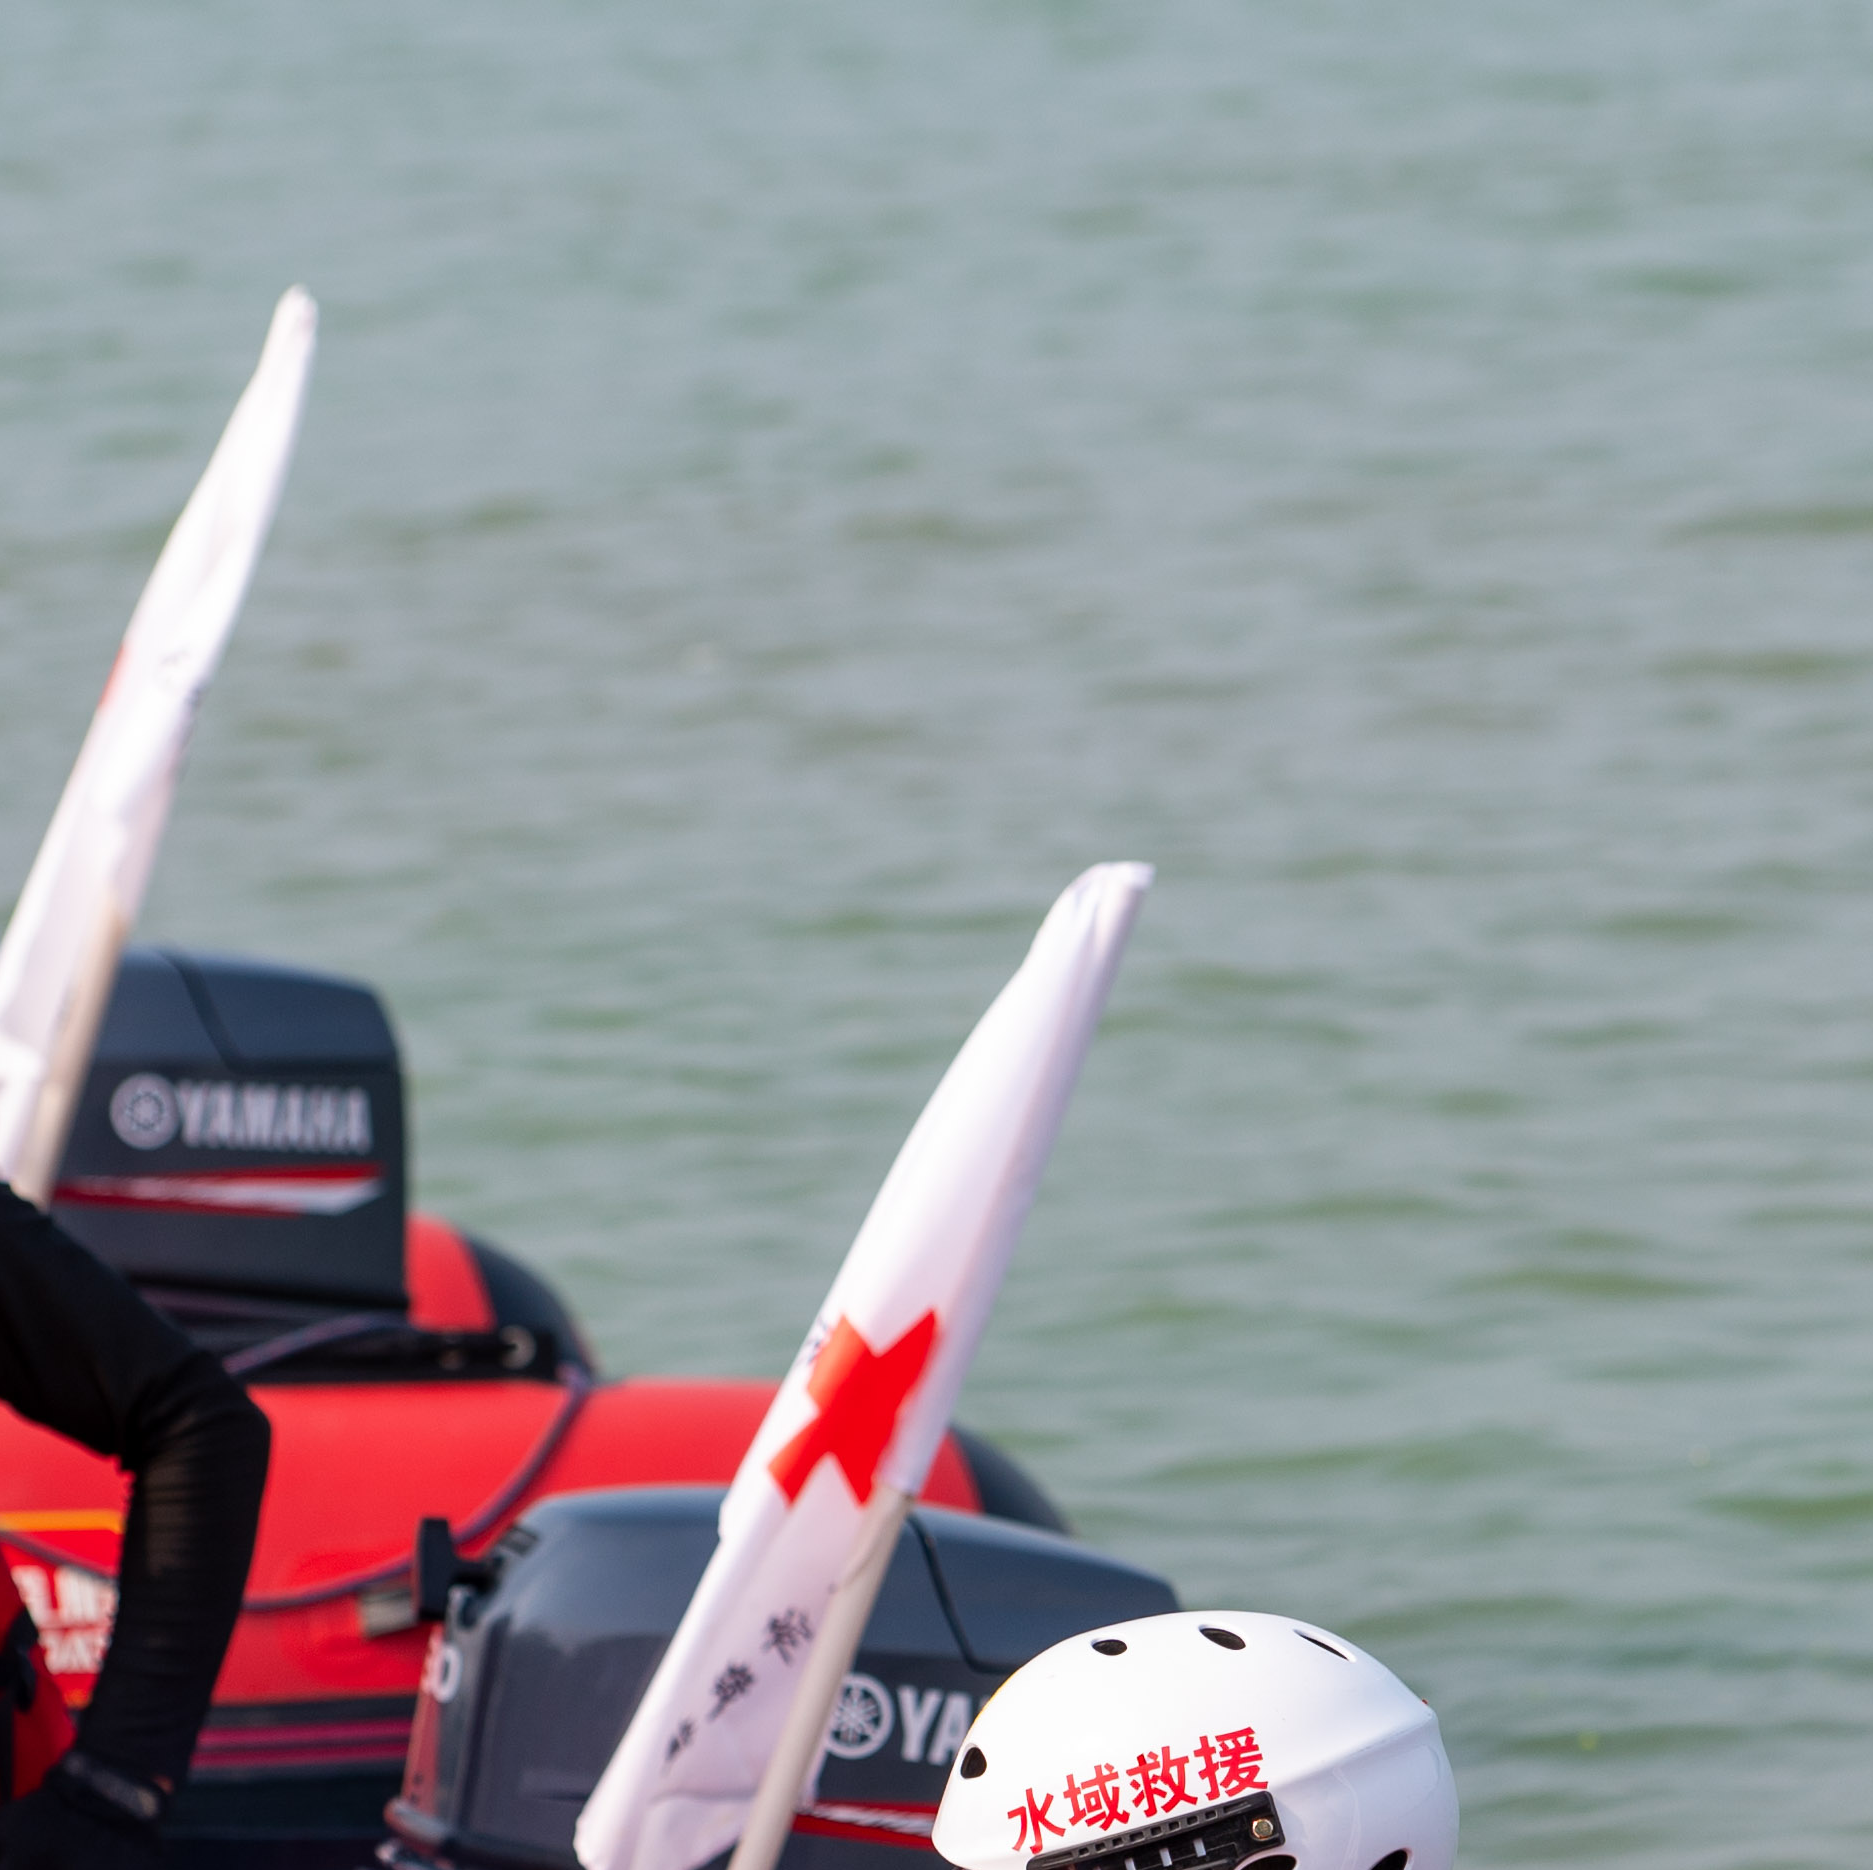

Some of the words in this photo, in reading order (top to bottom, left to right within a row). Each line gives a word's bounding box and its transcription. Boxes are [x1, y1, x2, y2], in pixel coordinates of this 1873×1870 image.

[177, 1080, 373, 1154] YAMAHA
[1006, 1726, 1269, 1856] 水域救援
